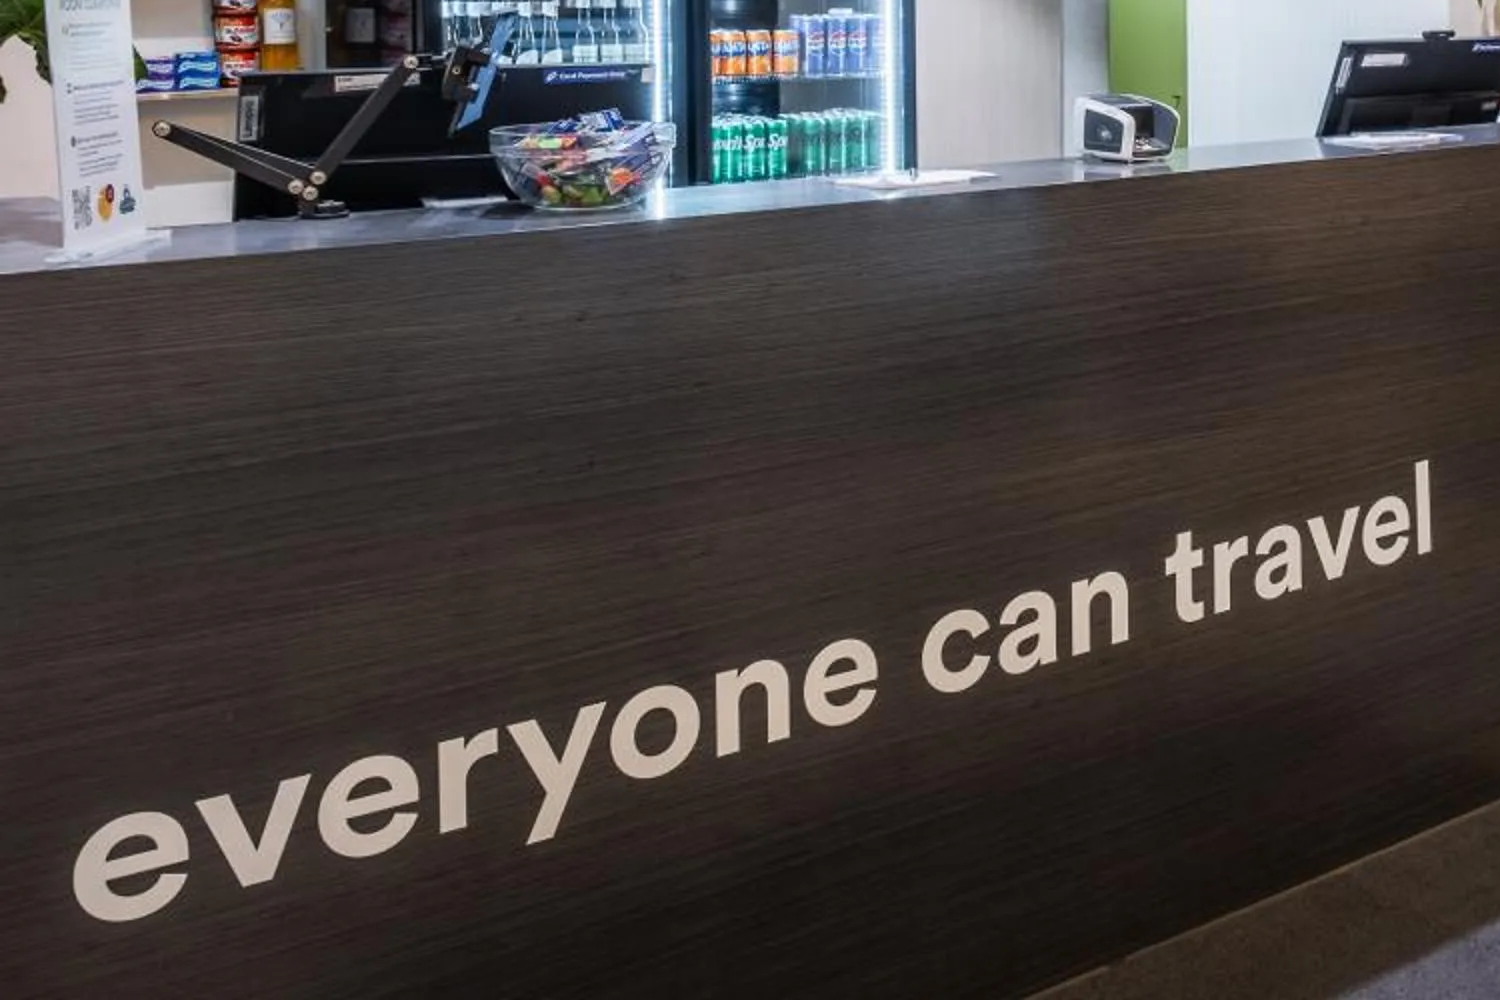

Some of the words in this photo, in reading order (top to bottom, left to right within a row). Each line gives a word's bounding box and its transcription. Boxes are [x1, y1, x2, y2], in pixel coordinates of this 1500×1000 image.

[72, 637, 879, 923] everyone
[921, 570, 1130, 694] can
[1164, 459, 1433, 624] travel
